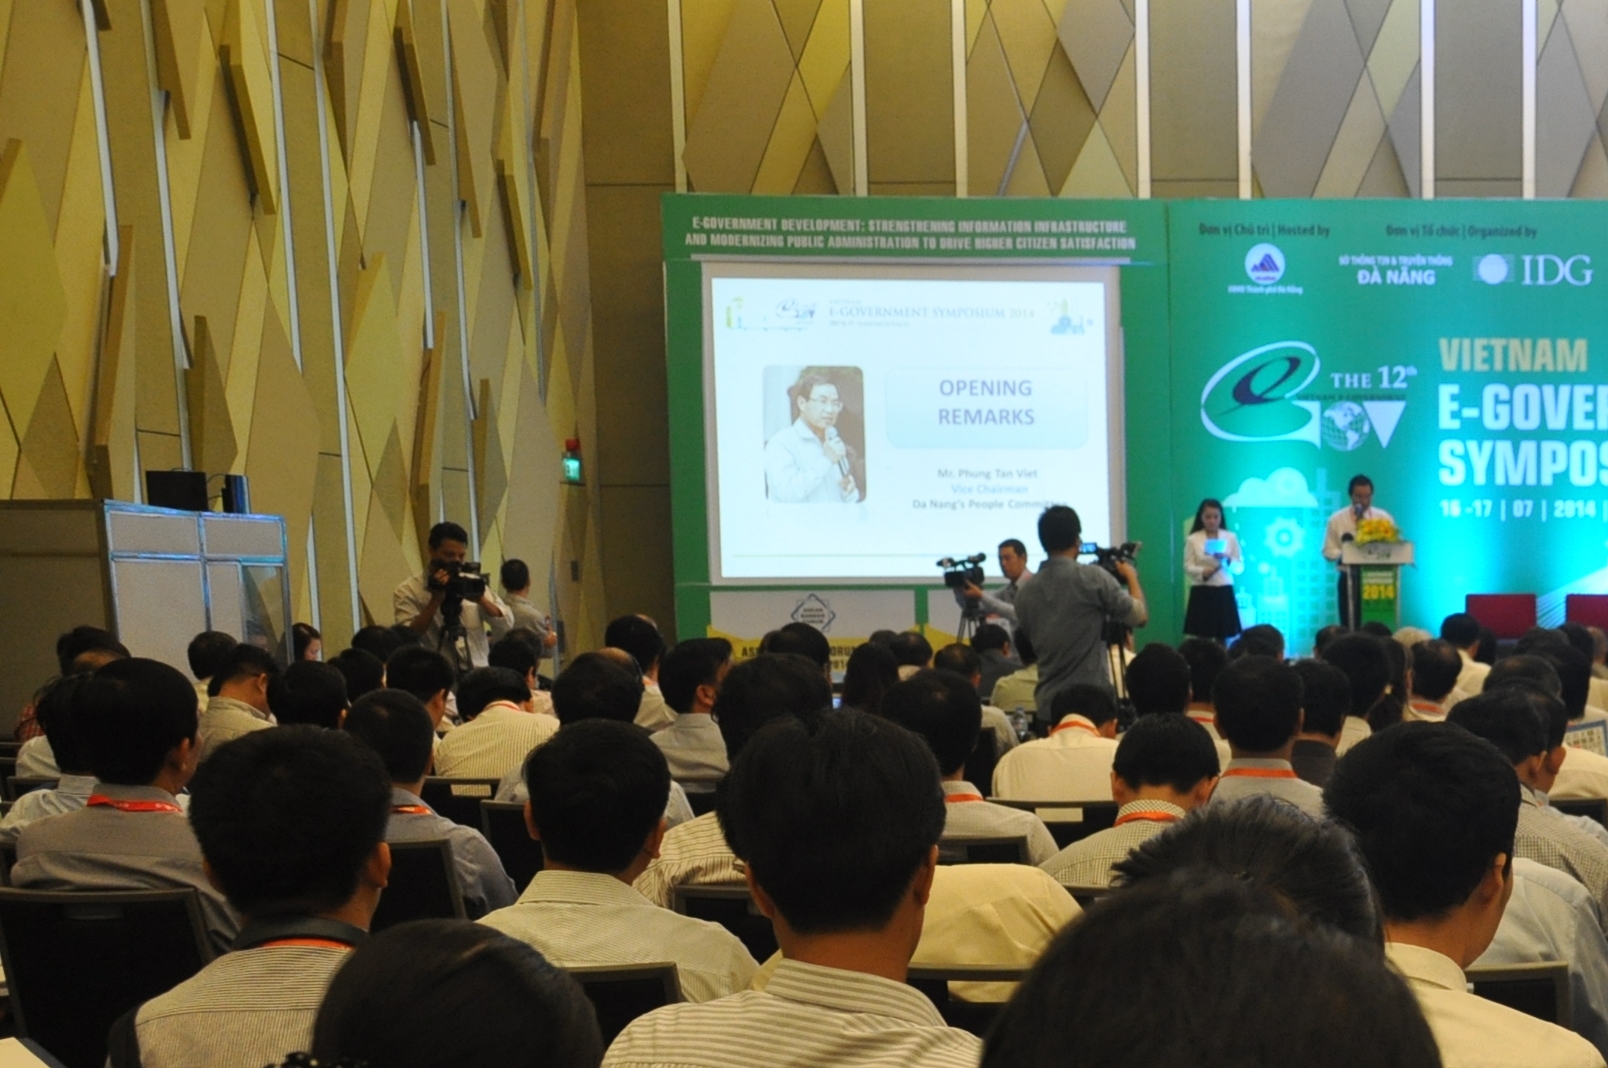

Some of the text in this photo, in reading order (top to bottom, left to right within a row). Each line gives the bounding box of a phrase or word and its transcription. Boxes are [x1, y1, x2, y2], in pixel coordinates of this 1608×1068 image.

[692, 216, 1126, 234] E-GOVERNMENT DEVELOPMENT: STRENGTHENING INFORMATION INFRASTRUCTURE
[1278, 224, 1316, 236] Hosted
[1318, 225, 1330, 238] by
[1468, 226, 1522, 239] Organized
[1524, 226, 1538, 239] by
[685, 233, 1136, 250] AND MODERNIZING PUBLIC ADMINISTRATION TO DRIVE HIGHER CITIZEN SATISFACTION
[1357, 266, 1382, 285] ĐÀ
[1522, 254, 1594, 286] IDG
[830, 306, 1035, 320] E-GOVERNMENT SYMPOSIUM 2014
[1438, 338, 1588, 372] VIETNAM
[1330, 372, 1372, 388] THE
[939, 379, 1032, 398] OPENING
[938, 408, 1035, 426] REMARKS
[938, 468, 1038, 480] Mr. Phung Tan Viet
[952, 484, 1028, 494] Vice Chairman
[912, 500, 927, 508] Da
[930, 500, 966, 511] Nang's
[968, 500, 1004, 512] People
[1512, 499, 1534, 518] 07
[1554, 500, 1596, 518] 2014
[1362, 584, 1395, 600] 2014
